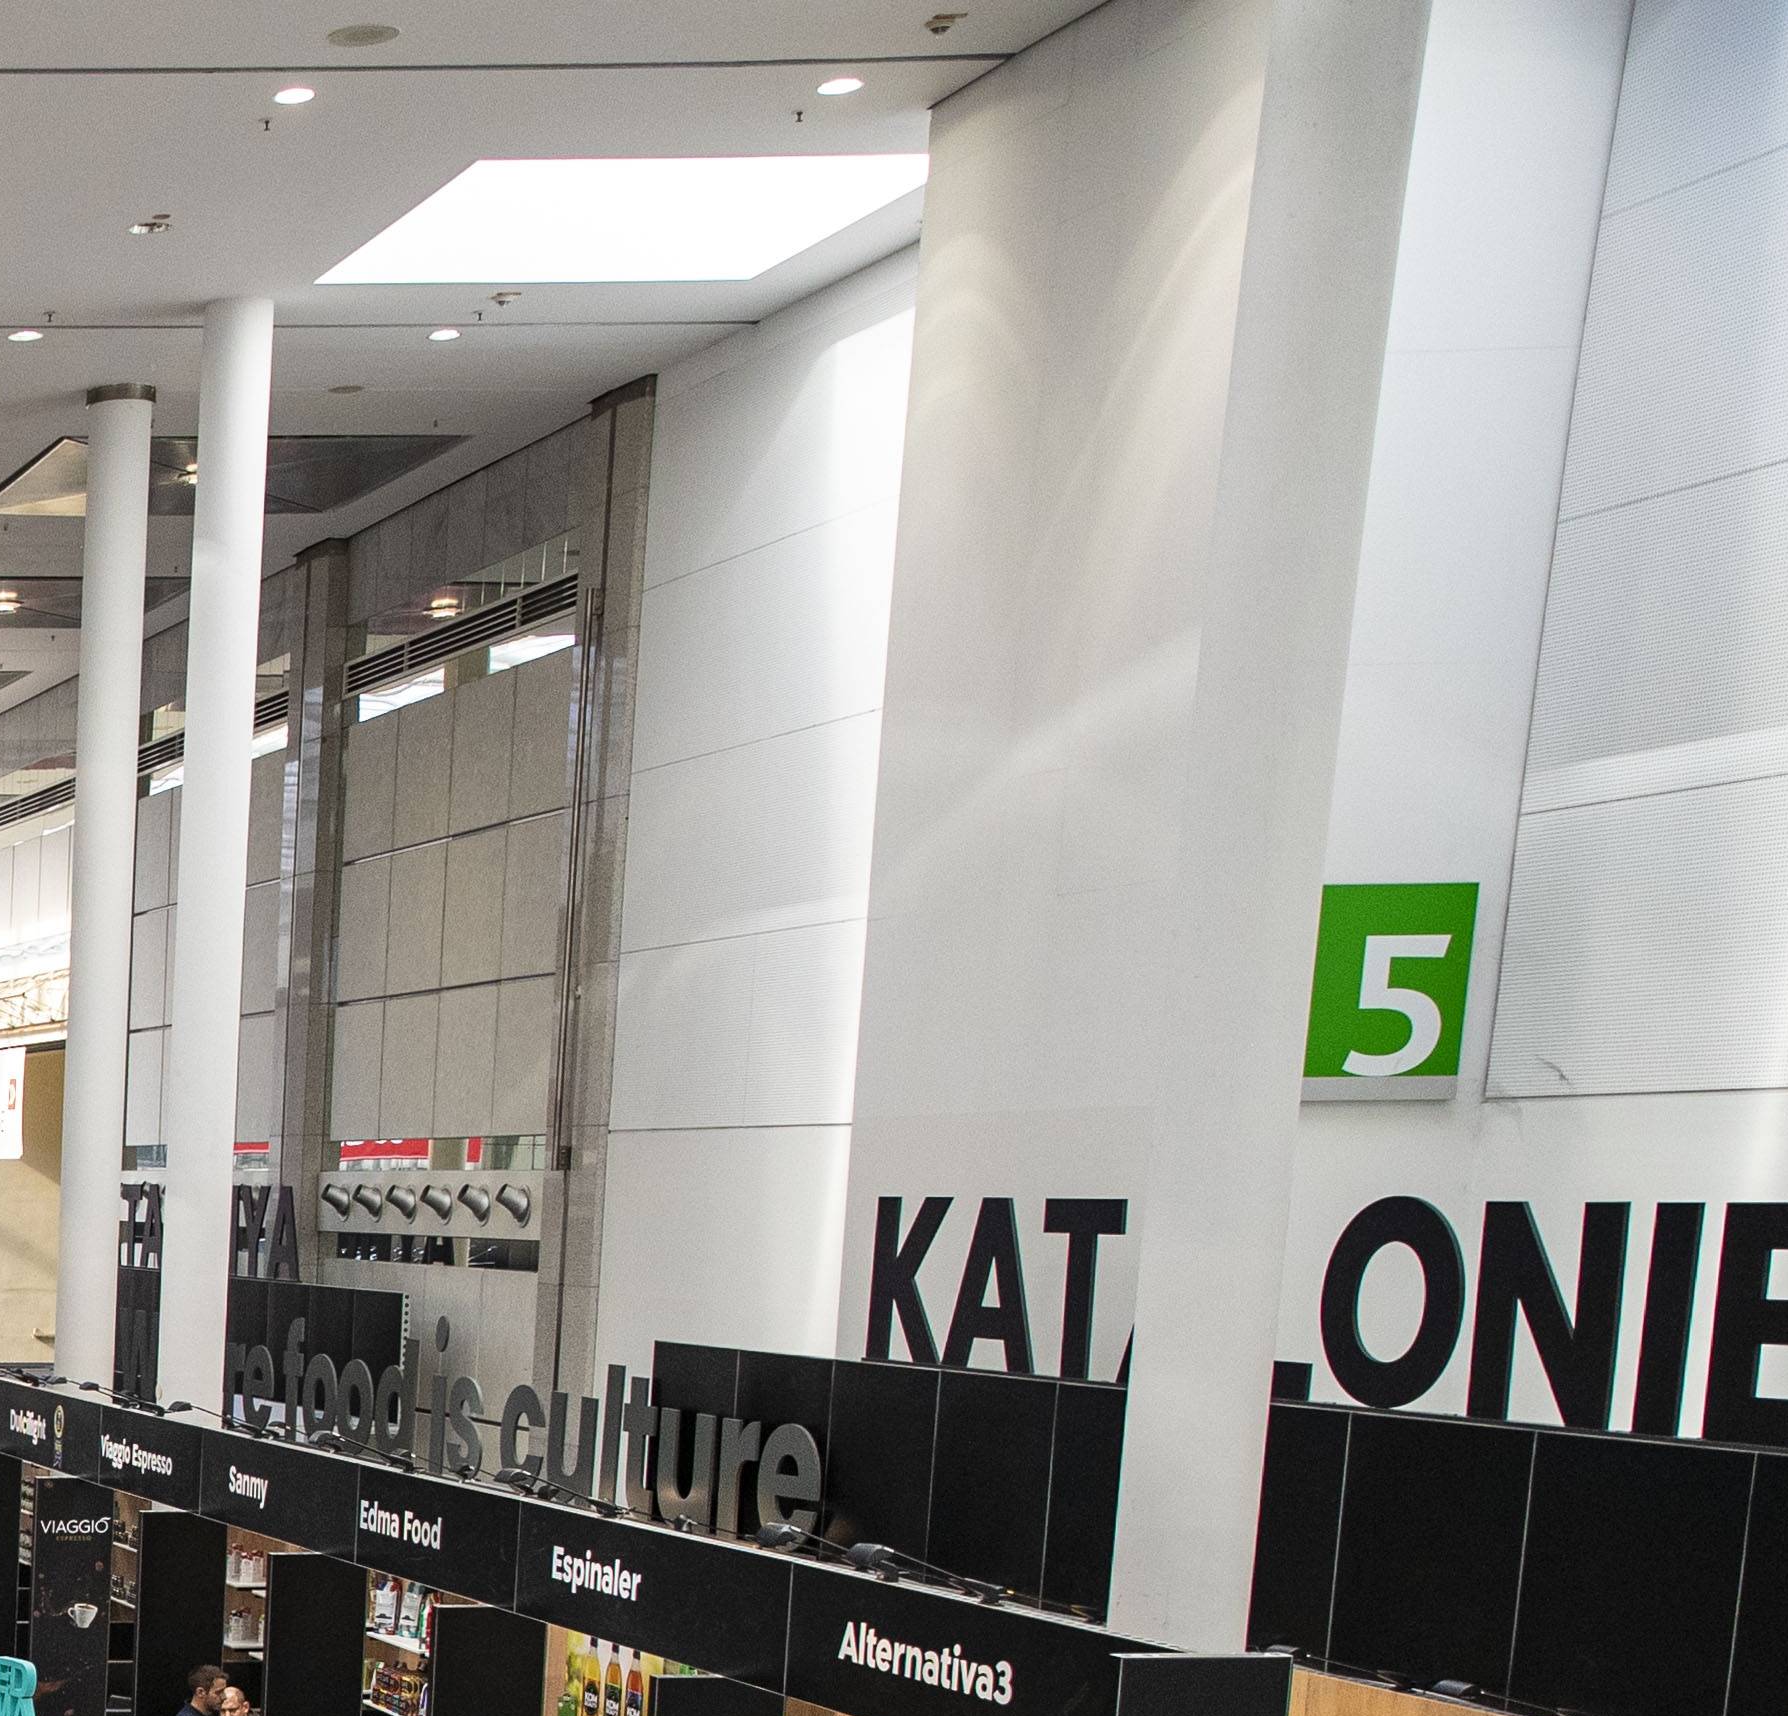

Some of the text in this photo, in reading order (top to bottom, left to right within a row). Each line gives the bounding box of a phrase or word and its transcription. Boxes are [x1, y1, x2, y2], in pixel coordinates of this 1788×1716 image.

[1341, 934, 1452, 1076] 5
[100, 1433, 131, 1470] Viaggio
[131, 1442, 173, 1477] Espresso
[285, 1317, 418, 1456] food
[428, 1315, 484, 1482] is
[500, 1364, 822, 1552] culture
[228, 1465, 269, 1510] Sanmy
[360, 1500, 443, 1550] Edma Food
[551, 1545, 643, 1603] Espinaler
[837, 1621, 1014, 1706] Alternativa3
